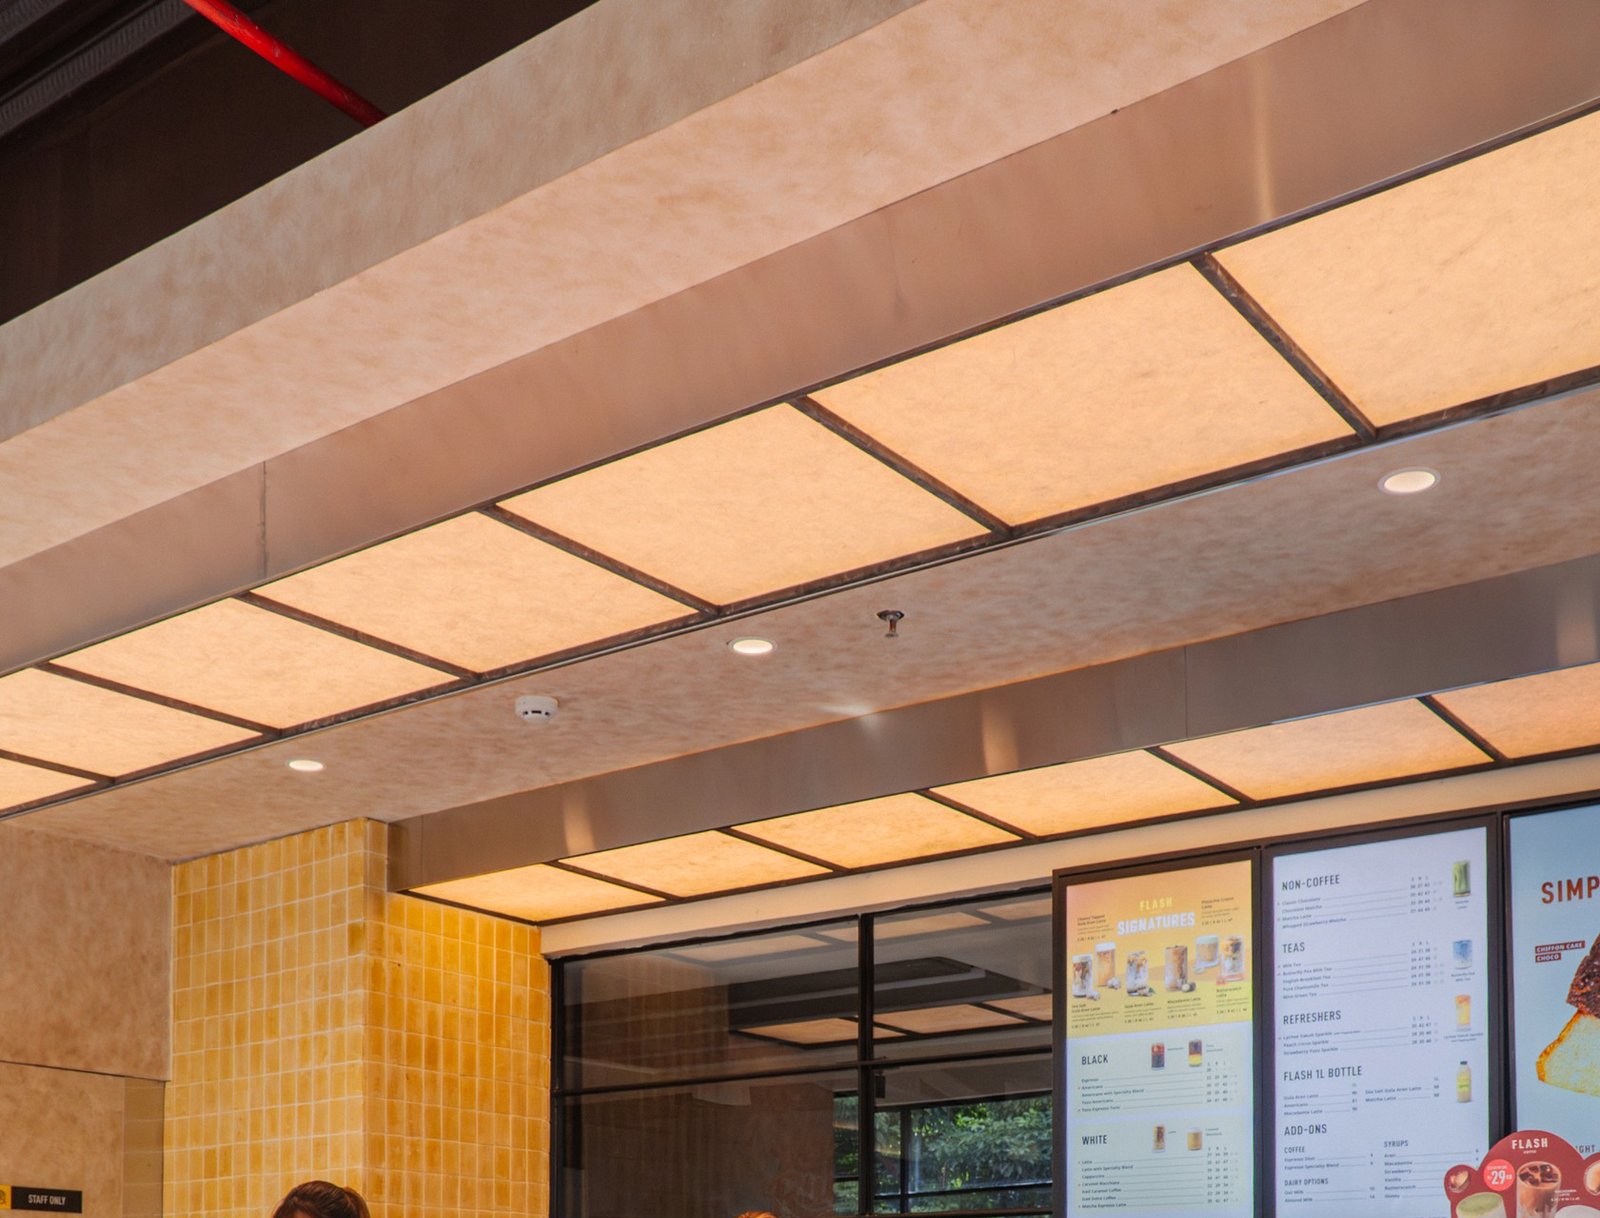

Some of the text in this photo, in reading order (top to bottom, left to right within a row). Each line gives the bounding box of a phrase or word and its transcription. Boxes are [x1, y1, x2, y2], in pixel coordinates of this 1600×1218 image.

[1282, 874, 1341, 891] NON-COFFEE
[1139, 897, 1173, 911] FLASH
[1117, 912, 1196, 936] SIGNATURES
[1283, 942, 1305, 954] TEAS
[1537, 943, 1565, 953] CHIFFON
[1283, 1010, 1341, 1025] REFRESHERS
[1082, 1054, 1108, 1065] BLACK
[1283, 1065, 1363, 1081] FLASH 1L BOTTLE
[1284, 1124, 1327, 1136] ADD-ONS
[1082, 1135, 1107, 1145] WHITE
[1384, 1140, 1409, 1148] SYRUPS
[1512, 1138, 1548, 1149] FLASH
[1284, 1178, 1329, 1187] DAIRY OPTIONS
[28, 1194, 66, 1205] STAFF ONLY
